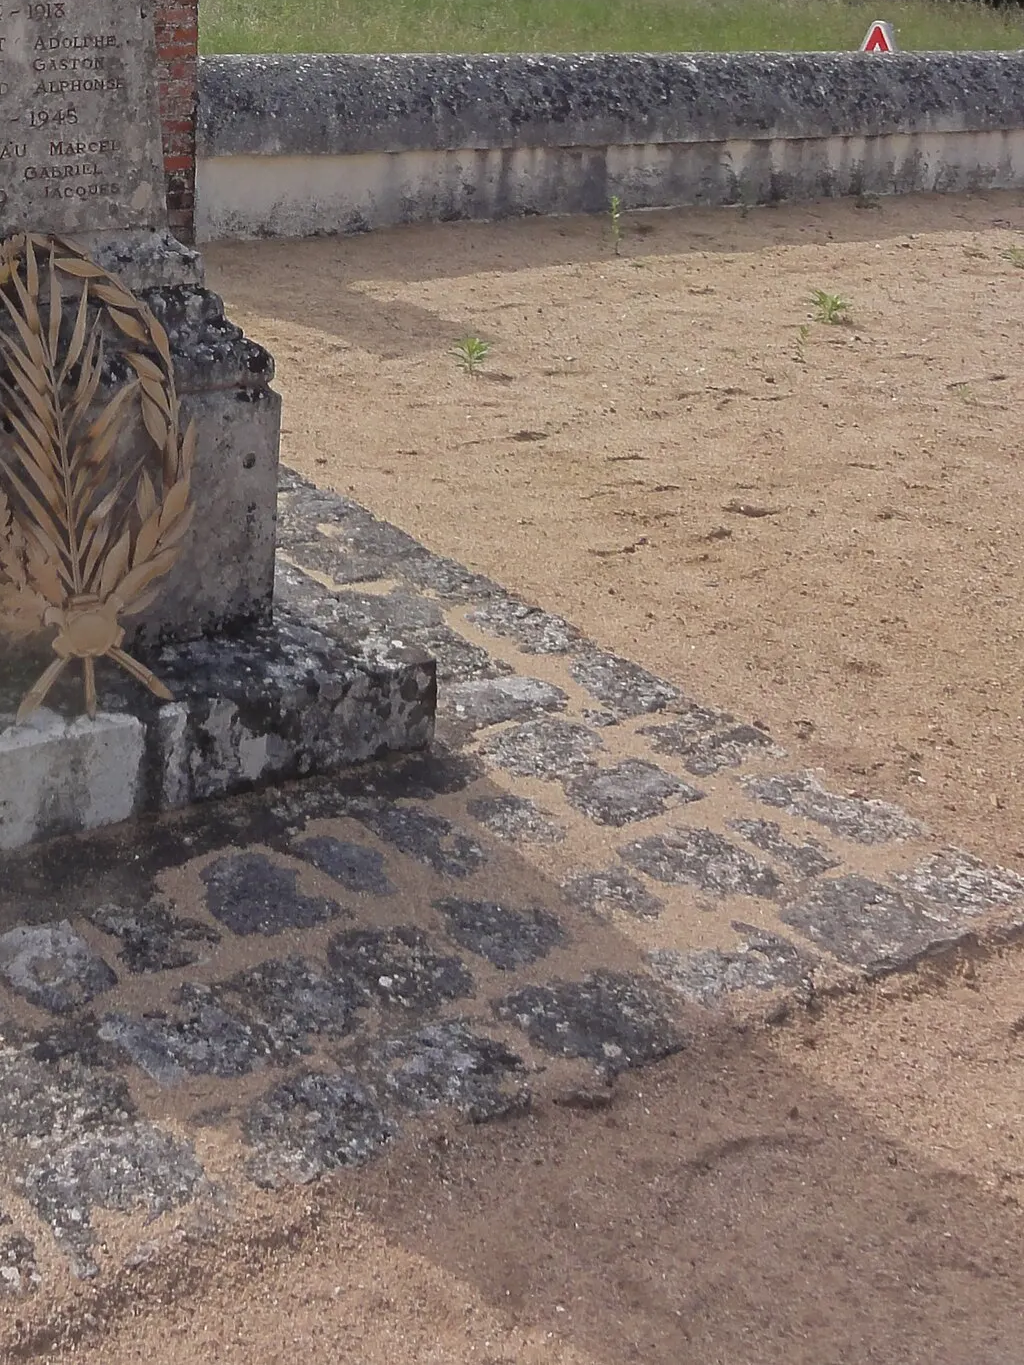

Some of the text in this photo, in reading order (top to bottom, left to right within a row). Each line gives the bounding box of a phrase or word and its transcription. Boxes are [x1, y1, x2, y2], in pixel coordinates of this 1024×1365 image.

[27, 2, 65, 21] 1918
[34, 35, 117, 50] ADOLPHE
[32, 57, 105, 72] GASTON
[33, 78, 124, 94] ALPHONSE
[29, 108, 79, 127] 1945
[49, 140, 121, 156] MARCEL
[24, 163, 103, 180] GABRIEL
